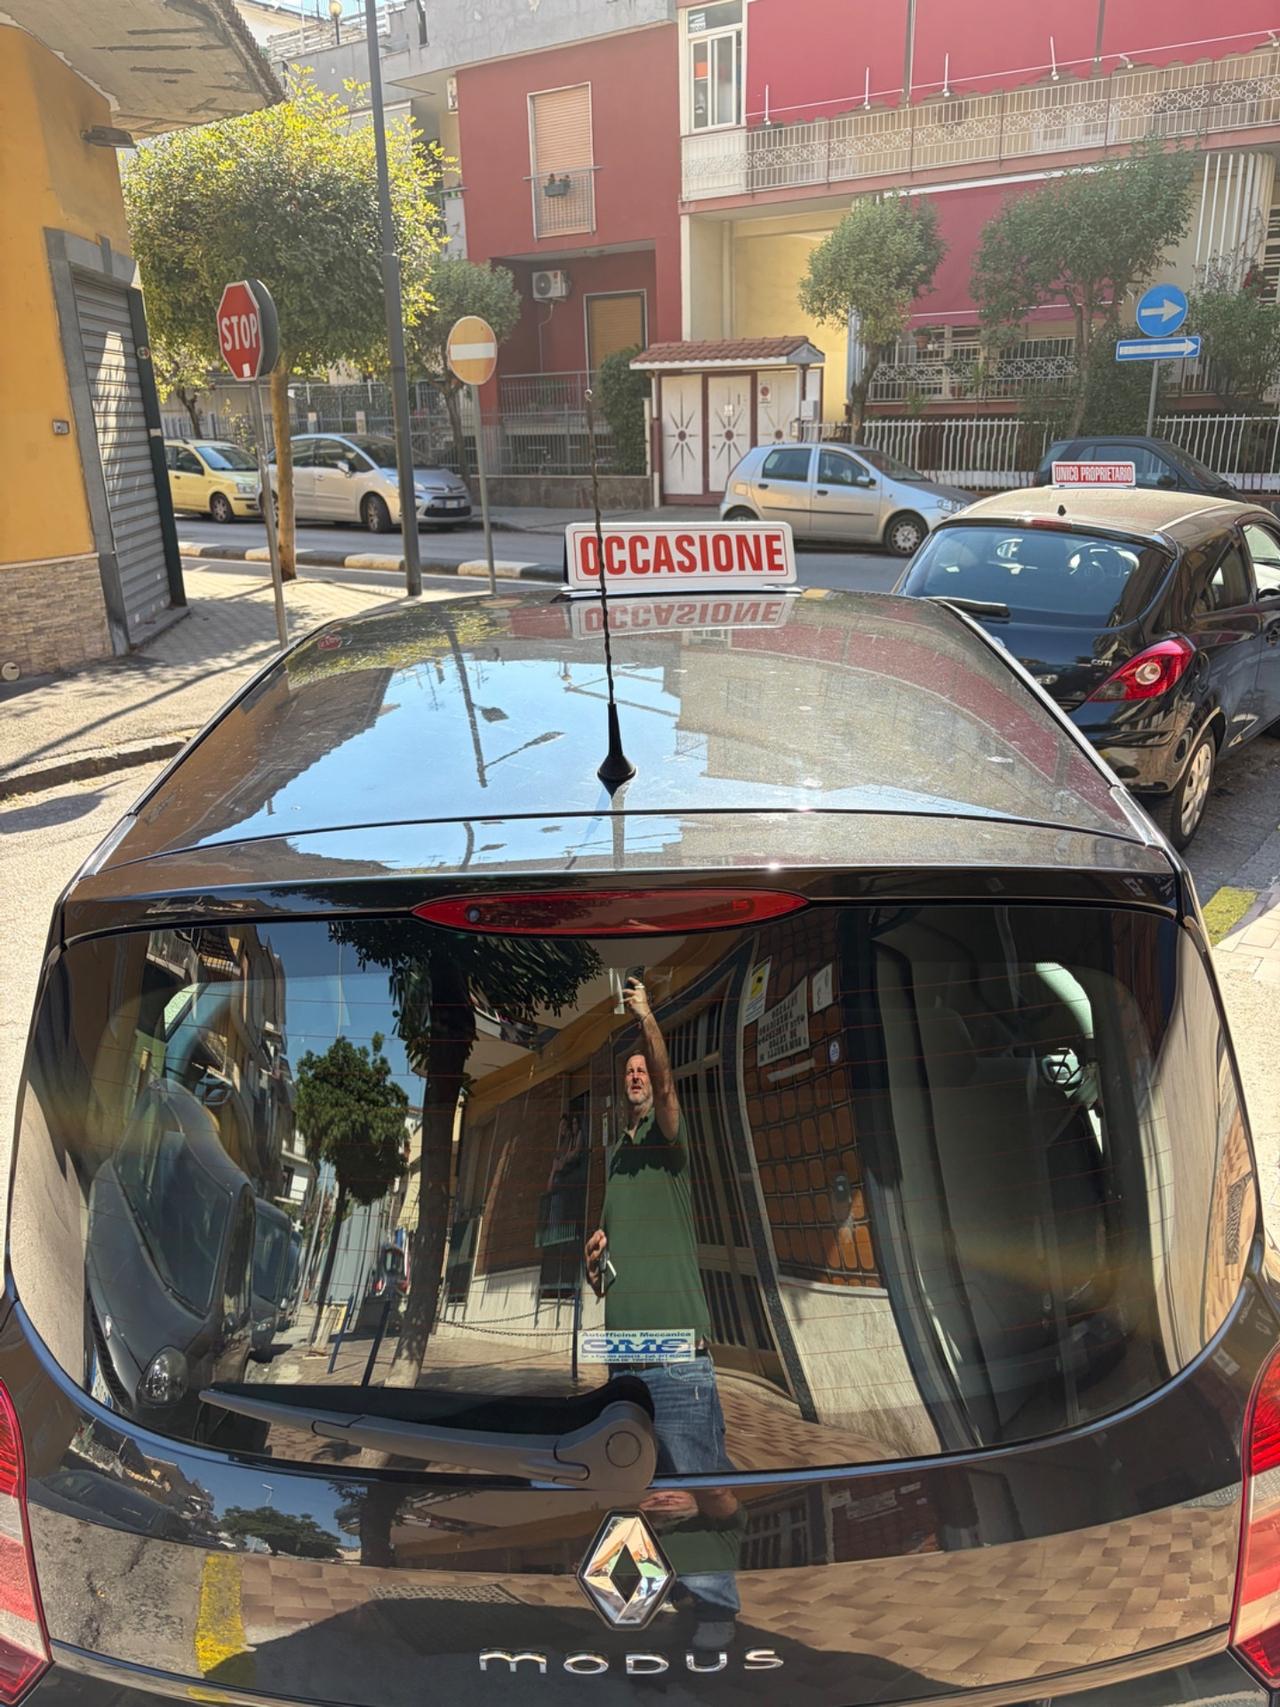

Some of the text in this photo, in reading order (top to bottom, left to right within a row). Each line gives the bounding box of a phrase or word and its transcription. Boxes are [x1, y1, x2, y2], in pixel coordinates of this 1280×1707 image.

[221, 313, 258, 352] STOP
[1055, 465, 1133, 482] UNICO PROPRIETARIO
[579, 533, 785, 576] OCCASIONE
[479, 1649, 785, 1675] MODUS
